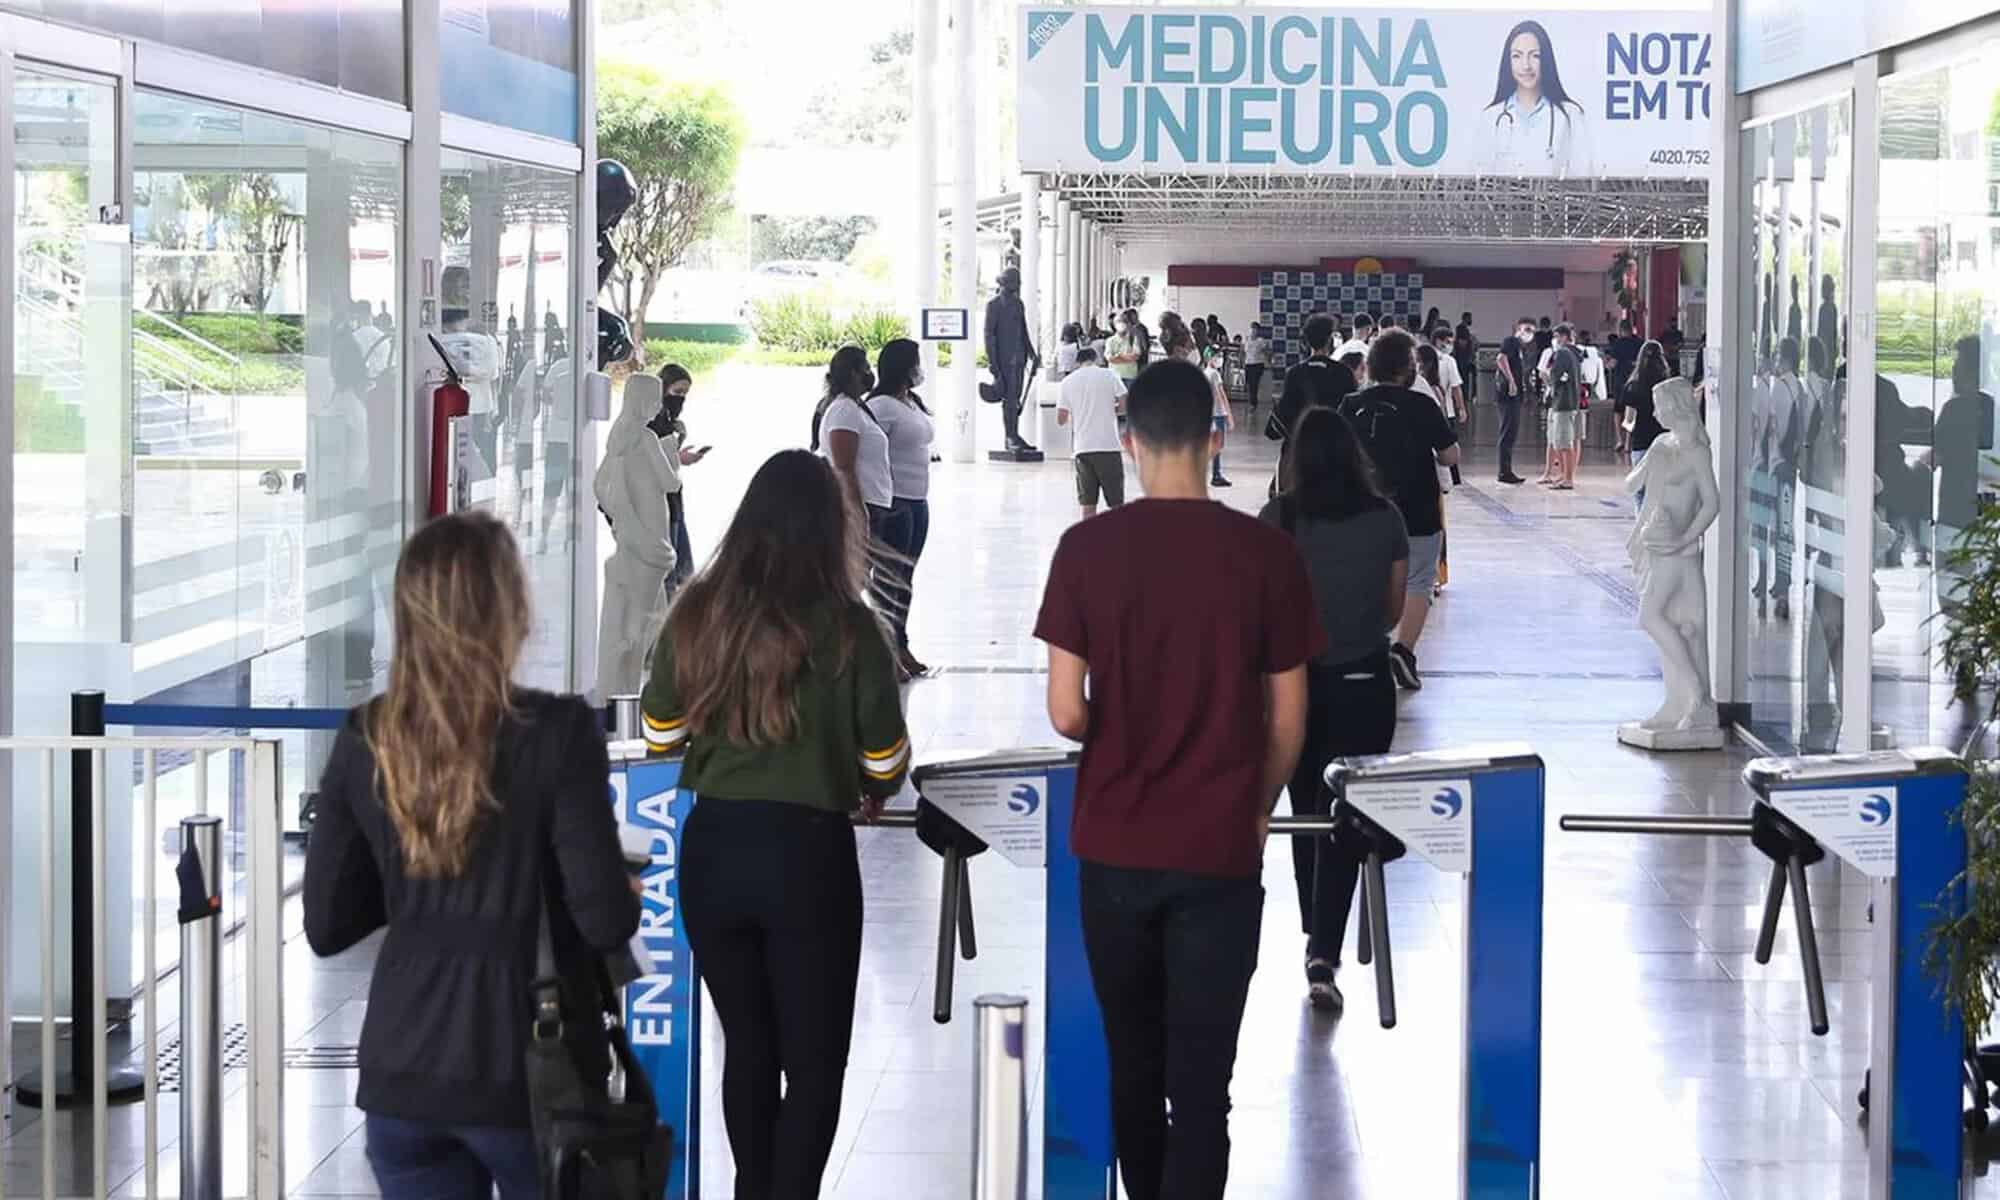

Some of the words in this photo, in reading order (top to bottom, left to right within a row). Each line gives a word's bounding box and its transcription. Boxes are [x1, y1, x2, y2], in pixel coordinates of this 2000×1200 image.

[1085, 14, 1448, 88] MEDICINA
[1606, 32, 1711, 76] NOTA
[1606, 80, 1667, 121] EM
[1084, 86, 1449, 167] UNIEURO
[1649, 149, 1711, 165] 4020.752
